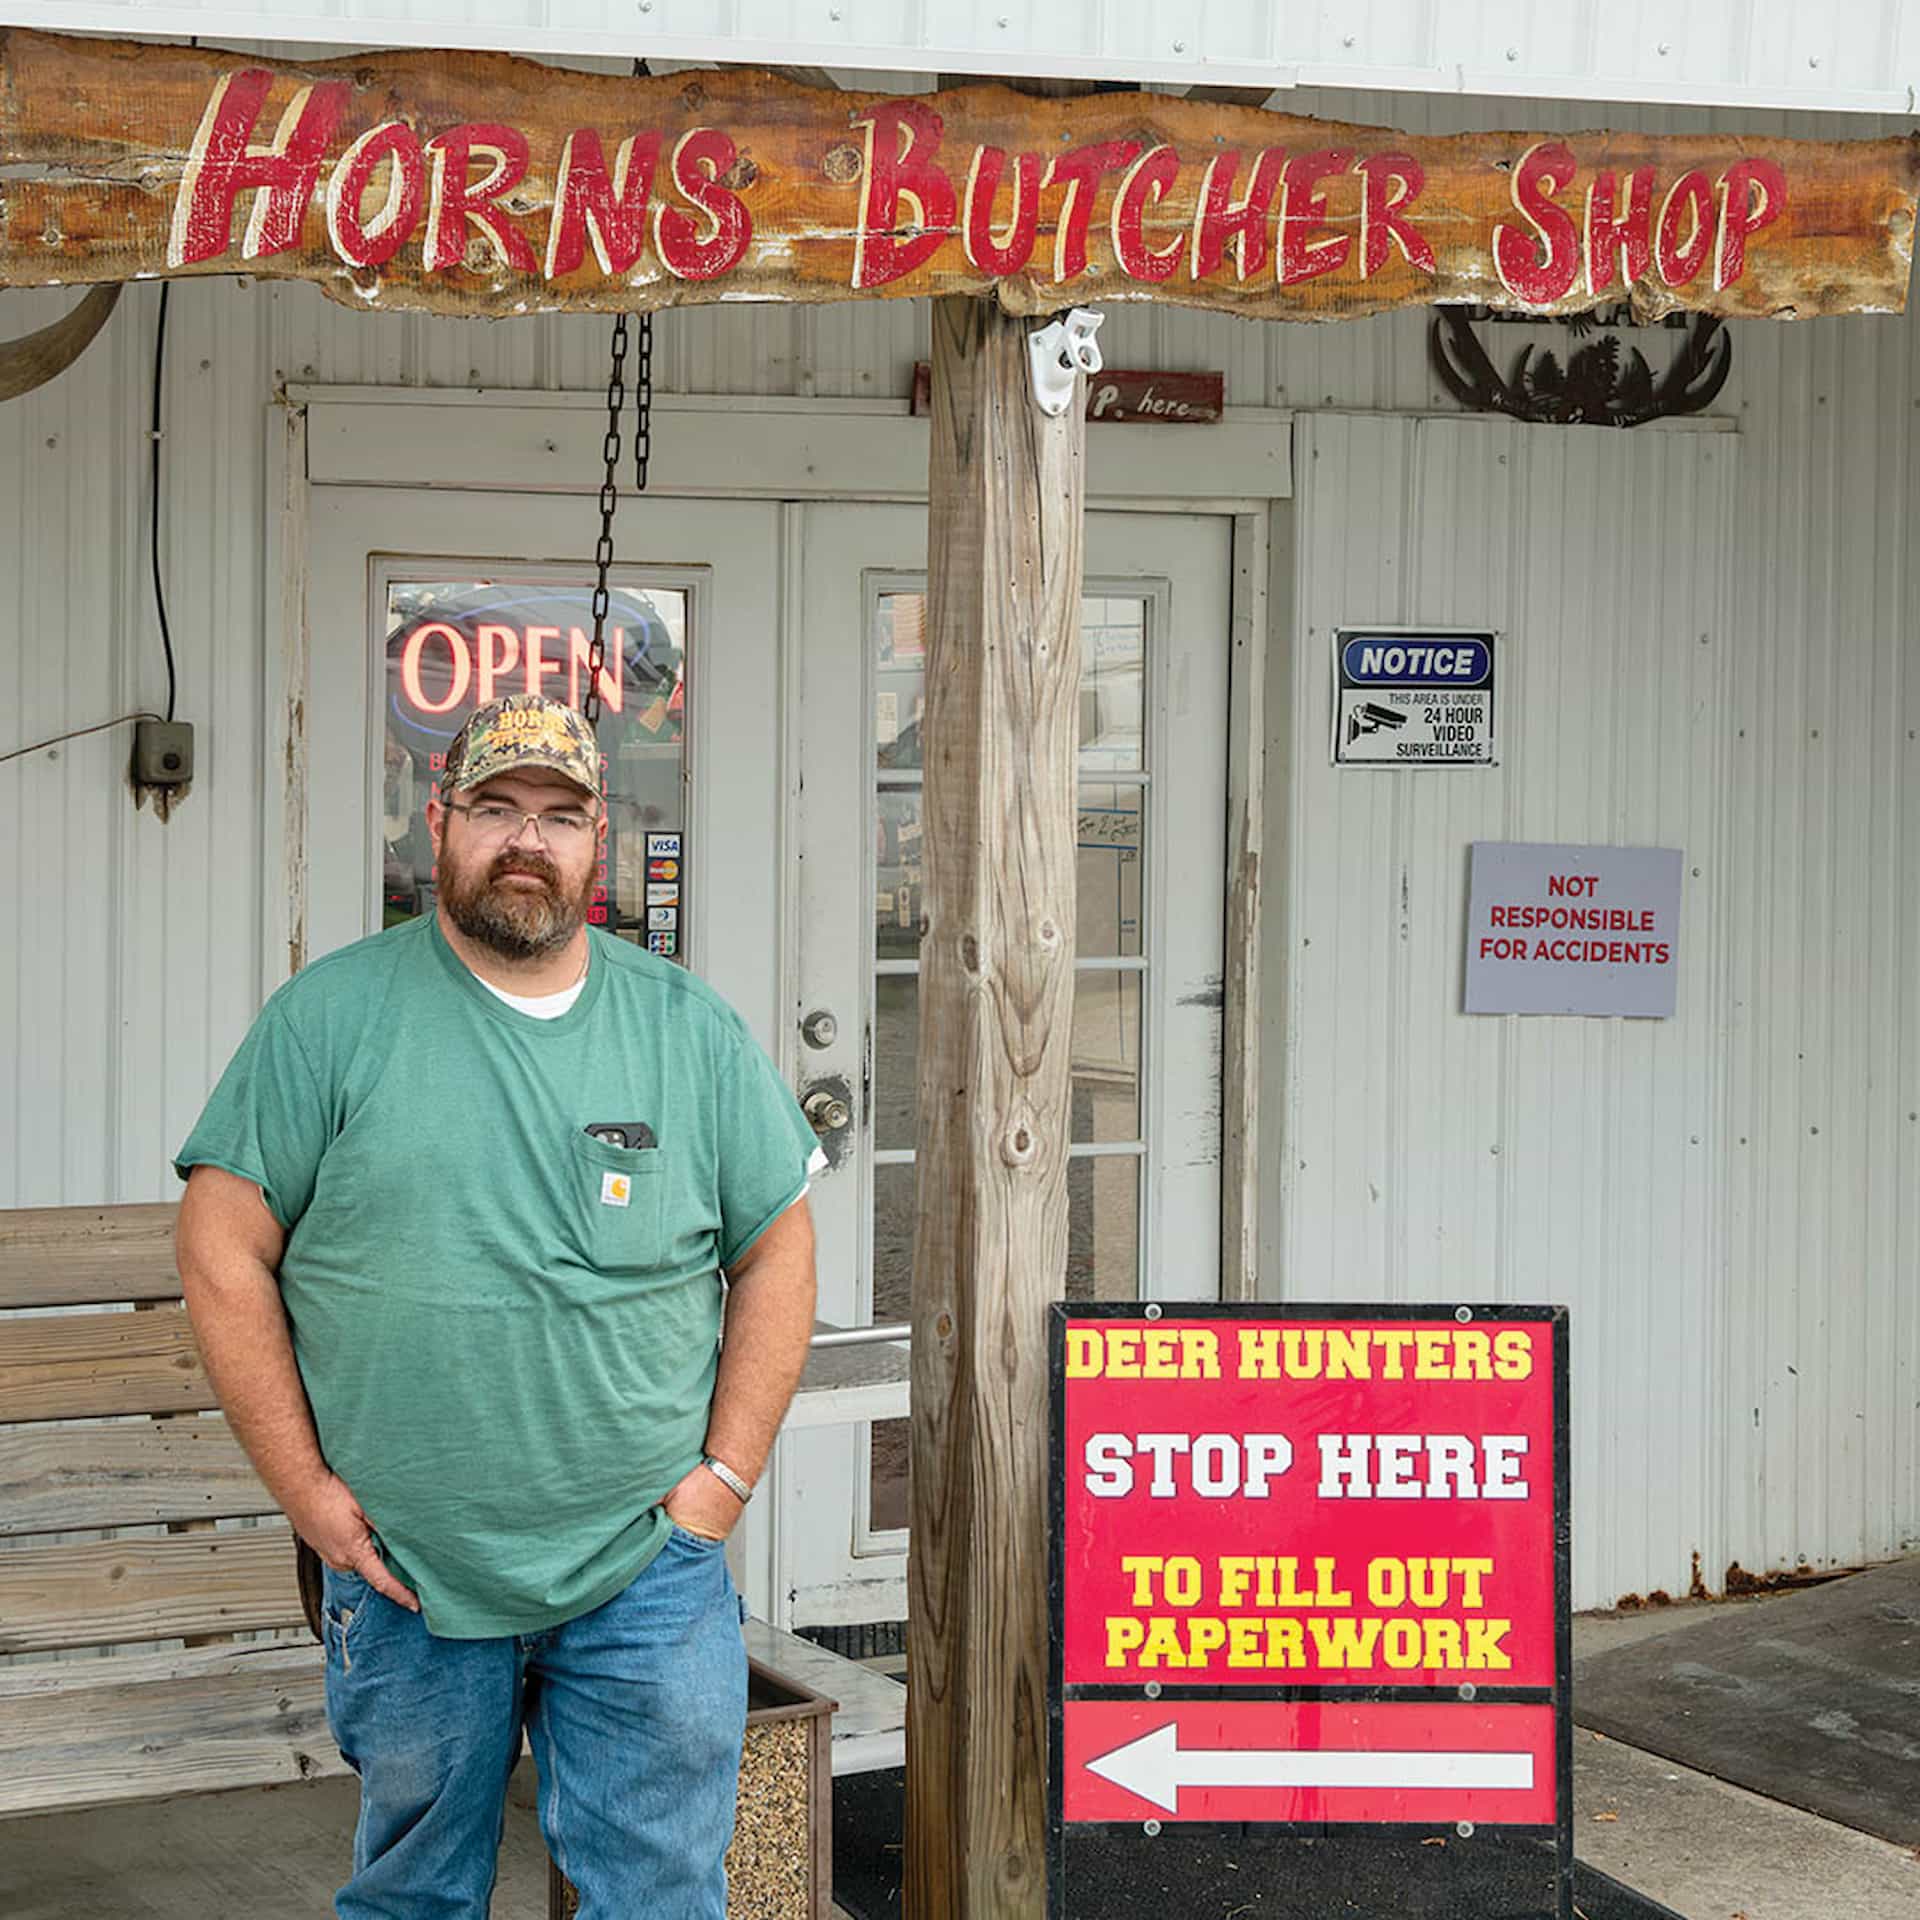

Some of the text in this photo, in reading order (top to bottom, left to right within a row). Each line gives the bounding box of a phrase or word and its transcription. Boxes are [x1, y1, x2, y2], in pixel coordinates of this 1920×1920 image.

[166, 66, 1786, 306] HORNS BUTCHER SHOP
[1086, 381, 1124, 418] P.
[401, 622, 625, 714] OPEN
[1360, 647, 1475, 675] NOTICE
[1389, 693, 1485, 706] THIS AREA IS UNDER
[1424, 707, 1484, 724] 24 HOUR
[1433, 725, 1475, 742] VIDEO
[1396, 743, 1483, 757] SURVEILLANCE
[651, 839, 679, 852] VISA
[1548, 875, 1600, 898] NOT
[1490, 906, 1656, 932] RESPONSIBLE
[1480, 938, 1670, 965] FOR ACCIDENTS
[1065, 1328, 1534, 1381] DEER HUNTERS
[1084, 1432, 1530, 1500] STOP HERE
[1121, 1556, 1495, 1609] TO FILL OUT
[1105, 1616, 1512, 1670] PAPERWORK
